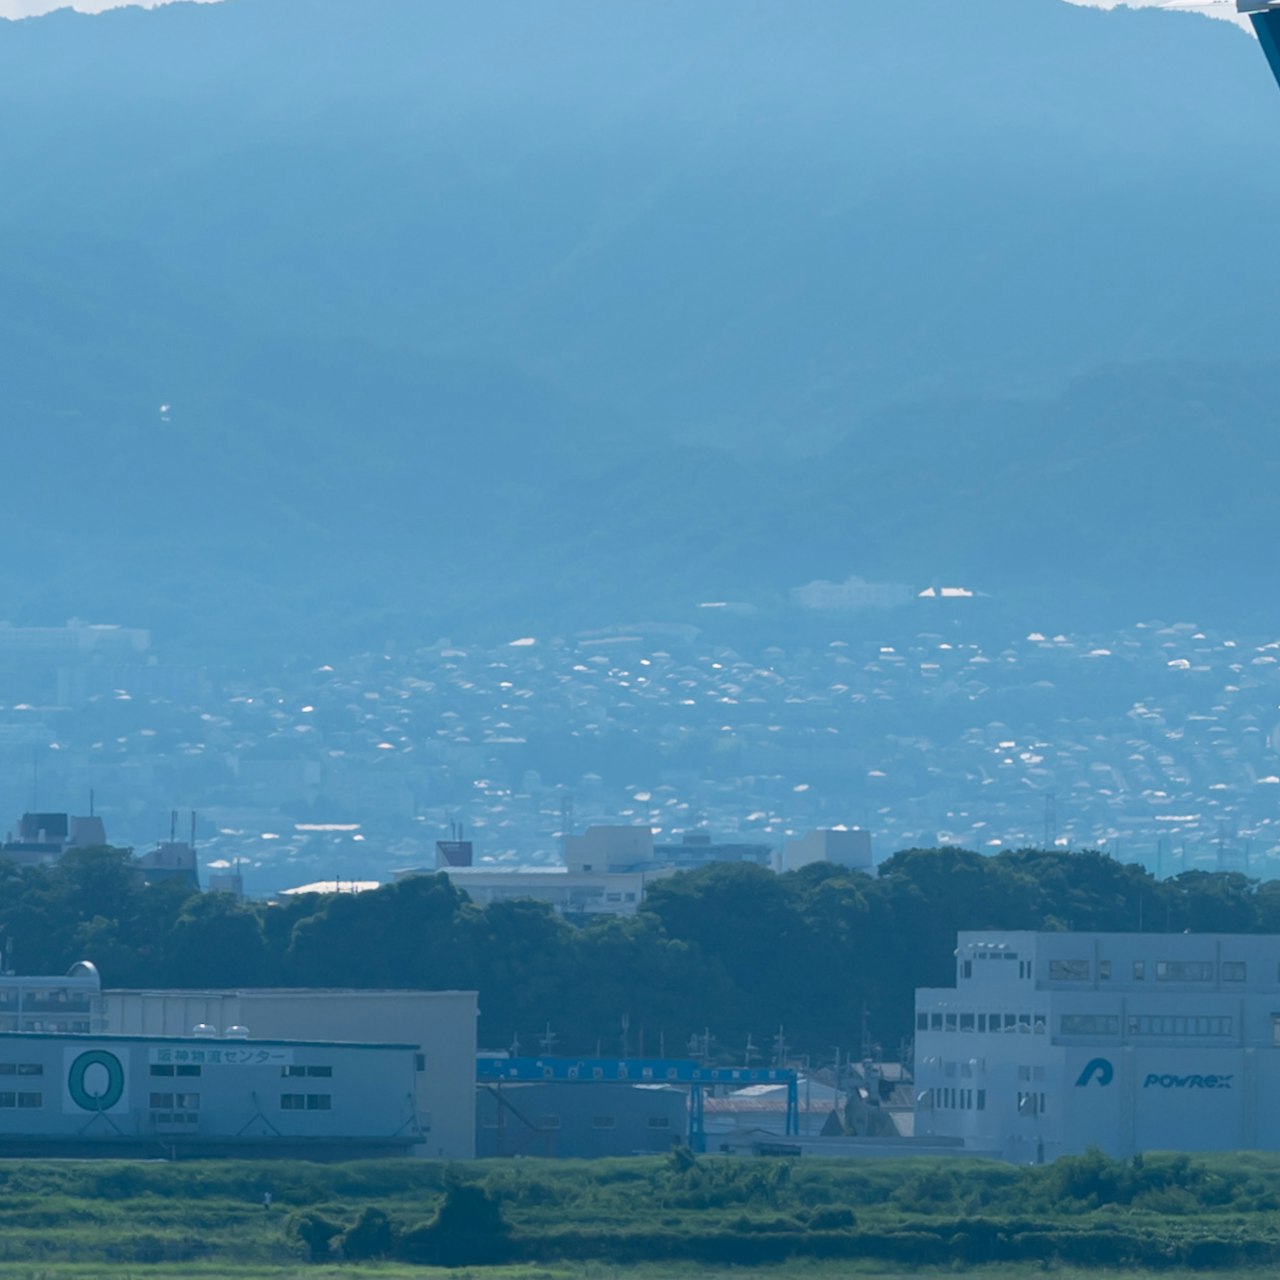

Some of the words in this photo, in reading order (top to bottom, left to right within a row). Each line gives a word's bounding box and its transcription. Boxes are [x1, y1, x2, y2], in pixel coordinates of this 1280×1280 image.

[157, 1048, 285, 1064] 阪神物流センター
